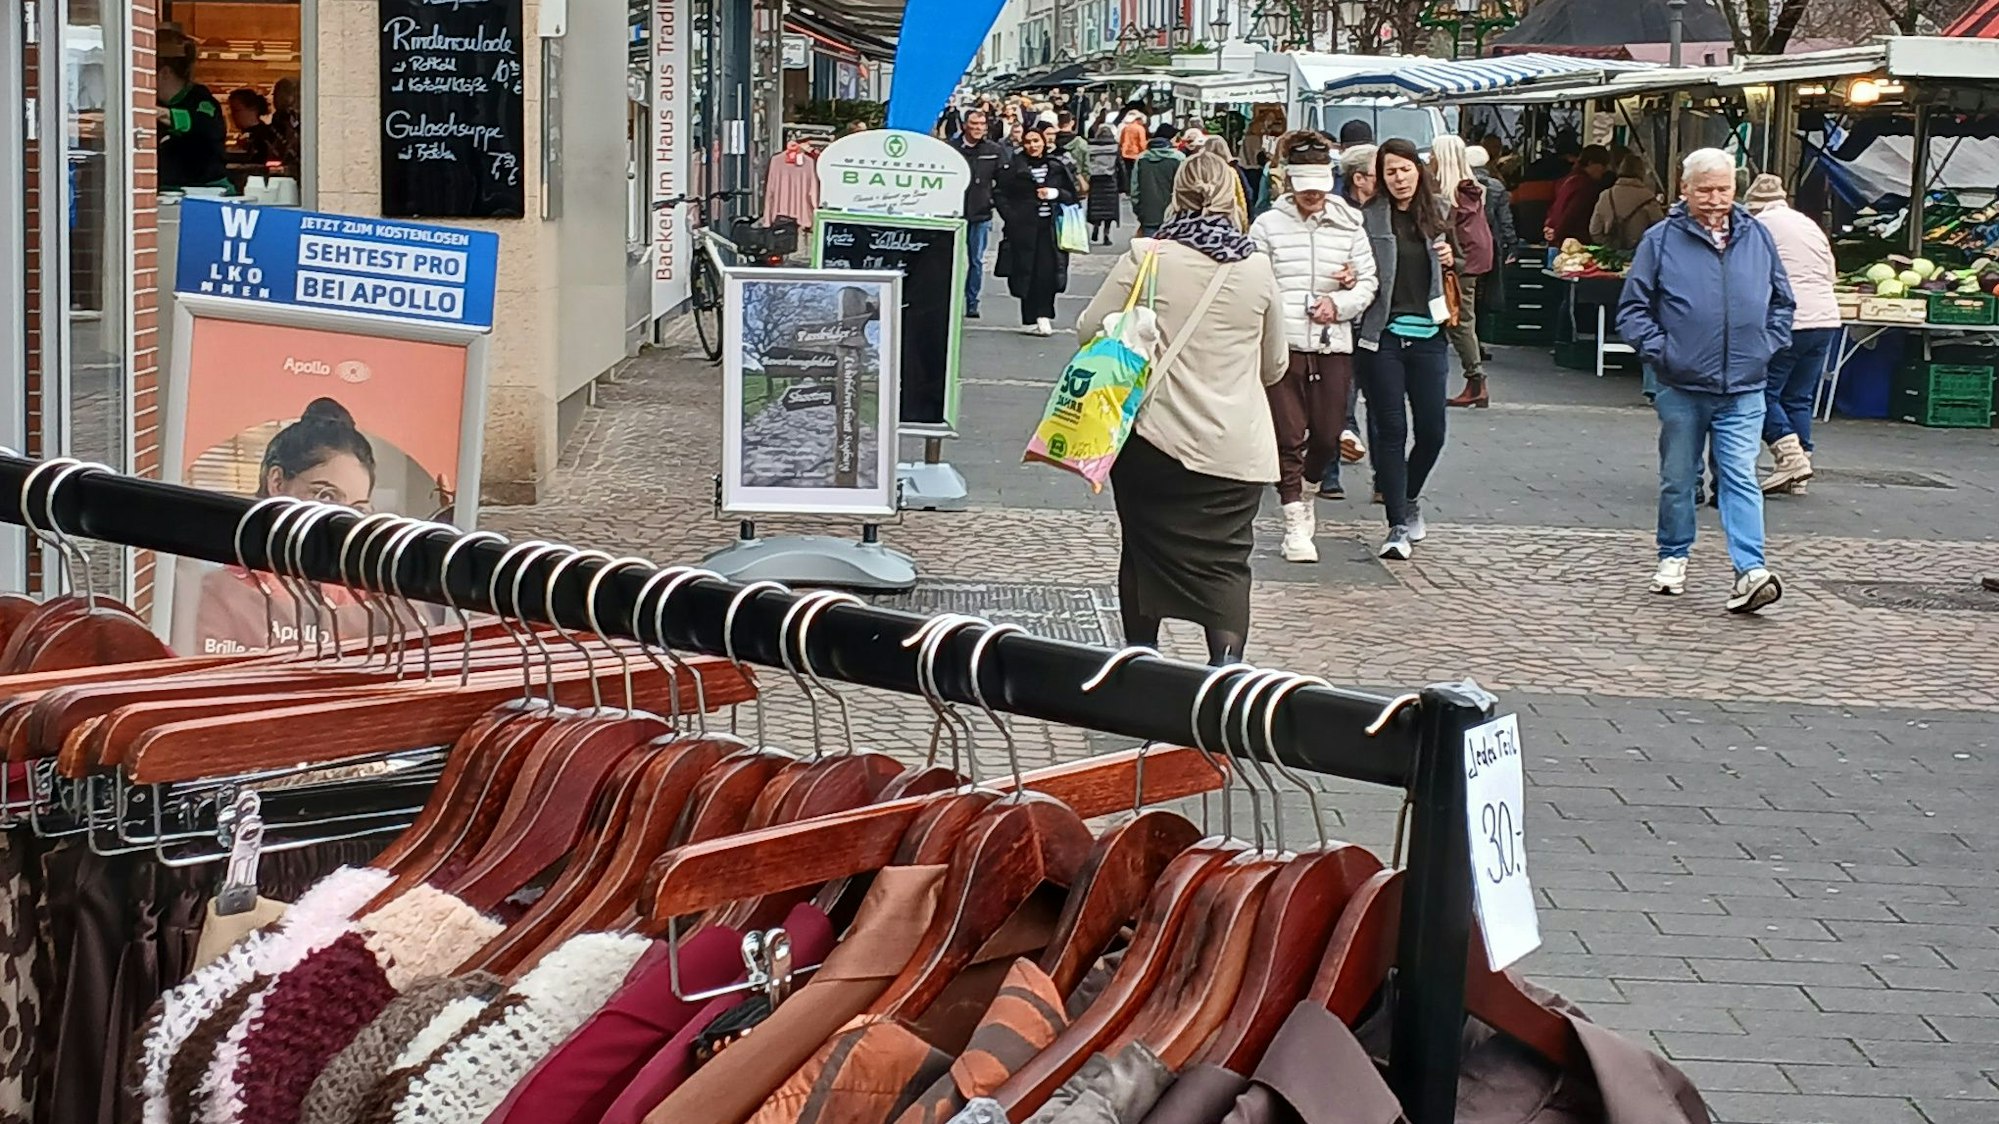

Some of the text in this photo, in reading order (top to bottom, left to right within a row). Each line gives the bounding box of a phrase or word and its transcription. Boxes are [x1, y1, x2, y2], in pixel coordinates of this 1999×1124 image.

[659, 64, 674, 101] aus
[385, 110, 504, 152] Gulaschsuppe
[656, 110, 674, 162] Haus
[842, 171, 943, 190] BAUM
[221, 206, 260, 239] W
[300, 216, 470, 246] JETZT ZUM KOSTENLOSEN
[222, 240, 254, 264] IL
[304, 242, 460, 276] SEHTEST PRO
[210, 263, 263, 284] LKO
[303, 276, 457, 313] BEI APOLLO
[283, 357, 331, 375] Apollo
